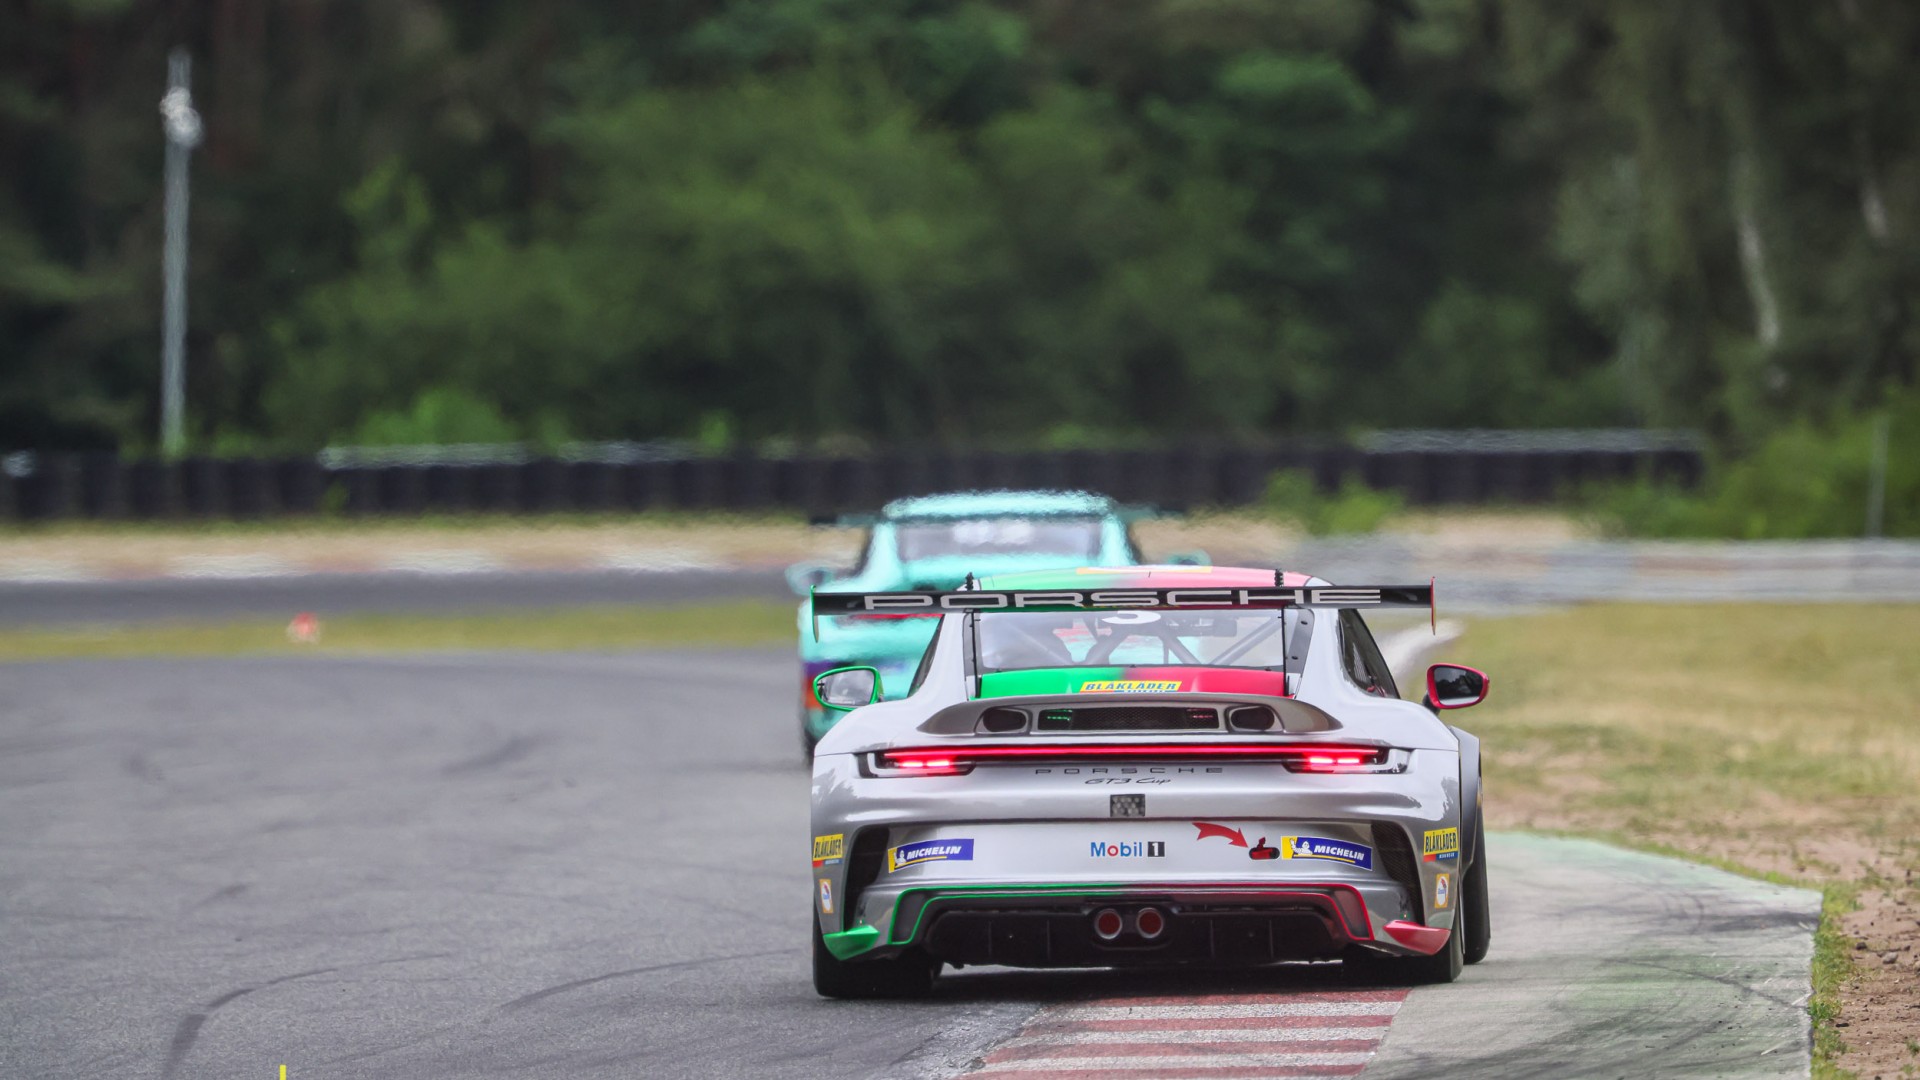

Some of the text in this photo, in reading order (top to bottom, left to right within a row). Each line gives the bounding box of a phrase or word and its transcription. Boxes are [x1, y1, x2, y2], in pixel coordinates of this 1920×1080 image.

[864, 589, 1381, 610] PORSCHE
[1084, 777, 1172, 786] GT3 Cup
[906, 846, 962, 860] MICHELIN
[1090, 841, 1142, 857] Mobil
[1313, 844, 1364, 861] MICHELIN
